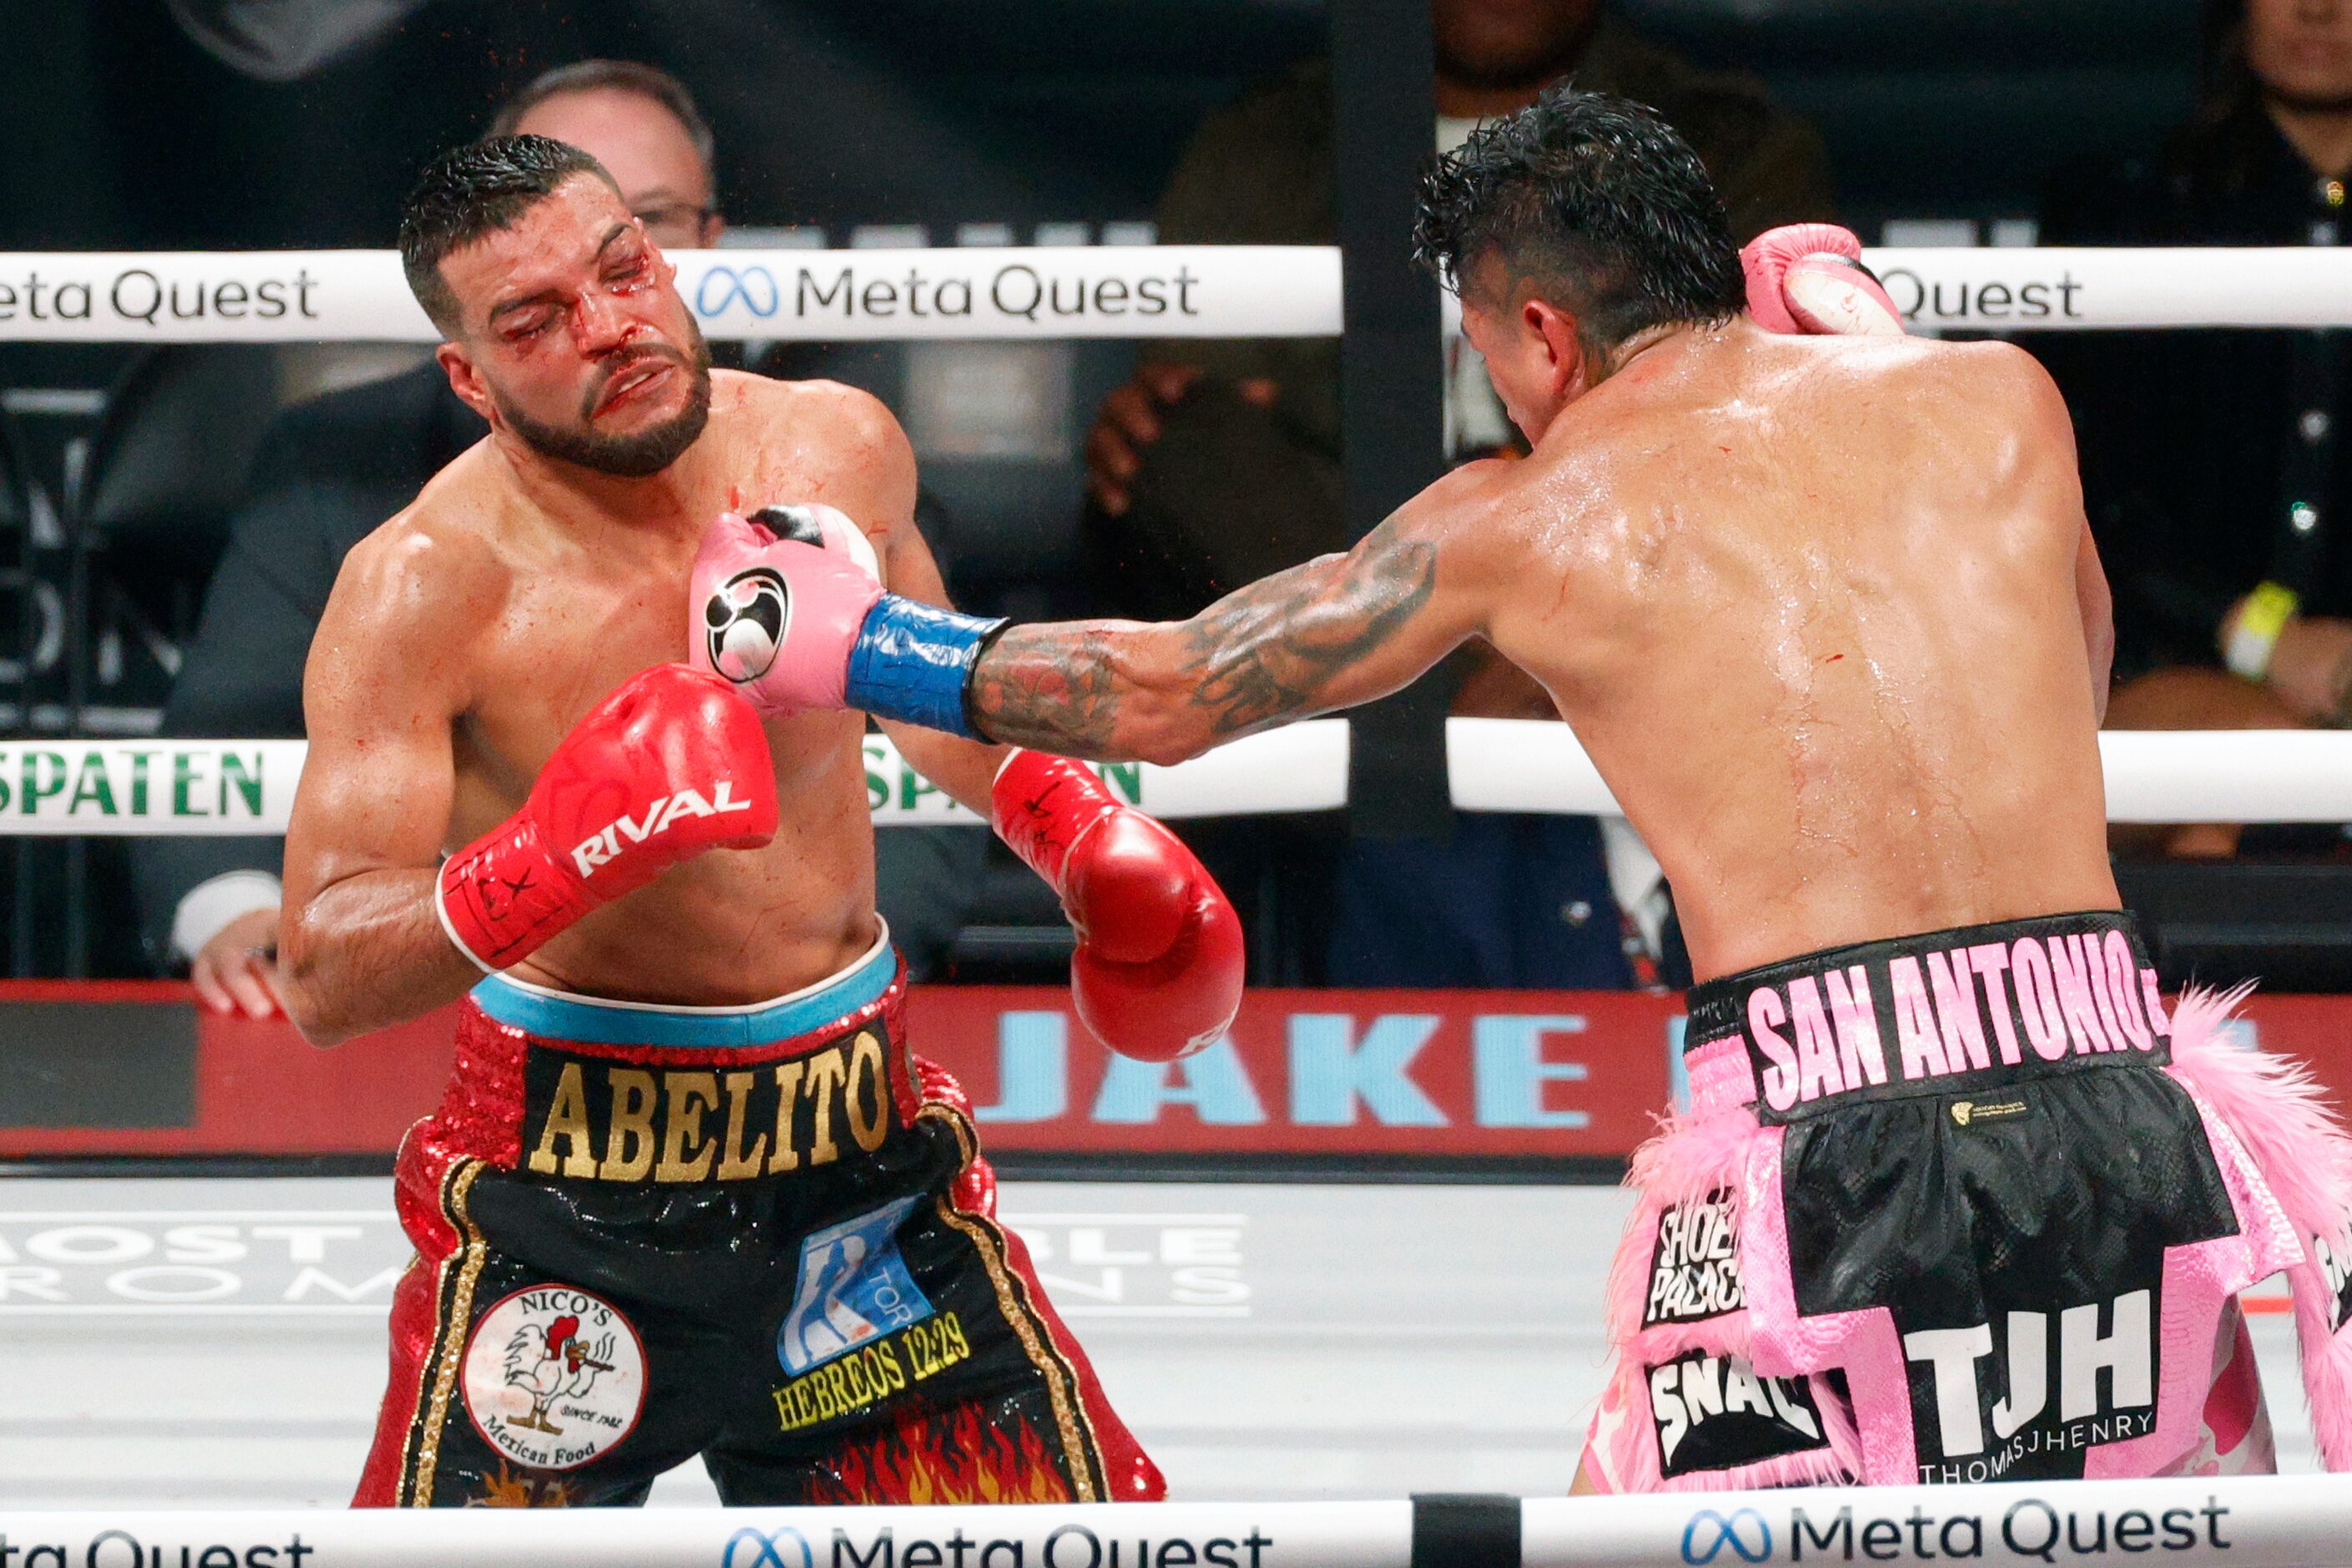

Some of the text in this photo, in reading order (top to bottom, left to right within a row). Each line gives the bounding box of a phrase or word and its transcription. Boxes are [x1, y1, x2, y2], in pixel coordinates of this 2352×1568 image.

[111, 268, 318, 326] Quest
[795, 264, 1200, 323] Meta Quest
[570, 781, 751, 879] RIVAL
[1748, 964, 1888, 1112] SAN
[1889, 929, 2154, 1080] ANTONIO
[974, 1009, 1590, 1128] JAKE
[528, 1031, 889, 1182] ABELITO
[519, 1291, 613, 1328] NICO'S
[772, 1311, 970, 1432] HEBREOS 12:29
[1904, 1288, 2152, 1457] TJH
[483, 1414, 595, 1465] Mexican Food
[86, 1529, 314, 1568] Quest
[831, 1523, 1273, 1568] Meta Quest
[1791, 1495, 2233, 1563] Meta Quest
